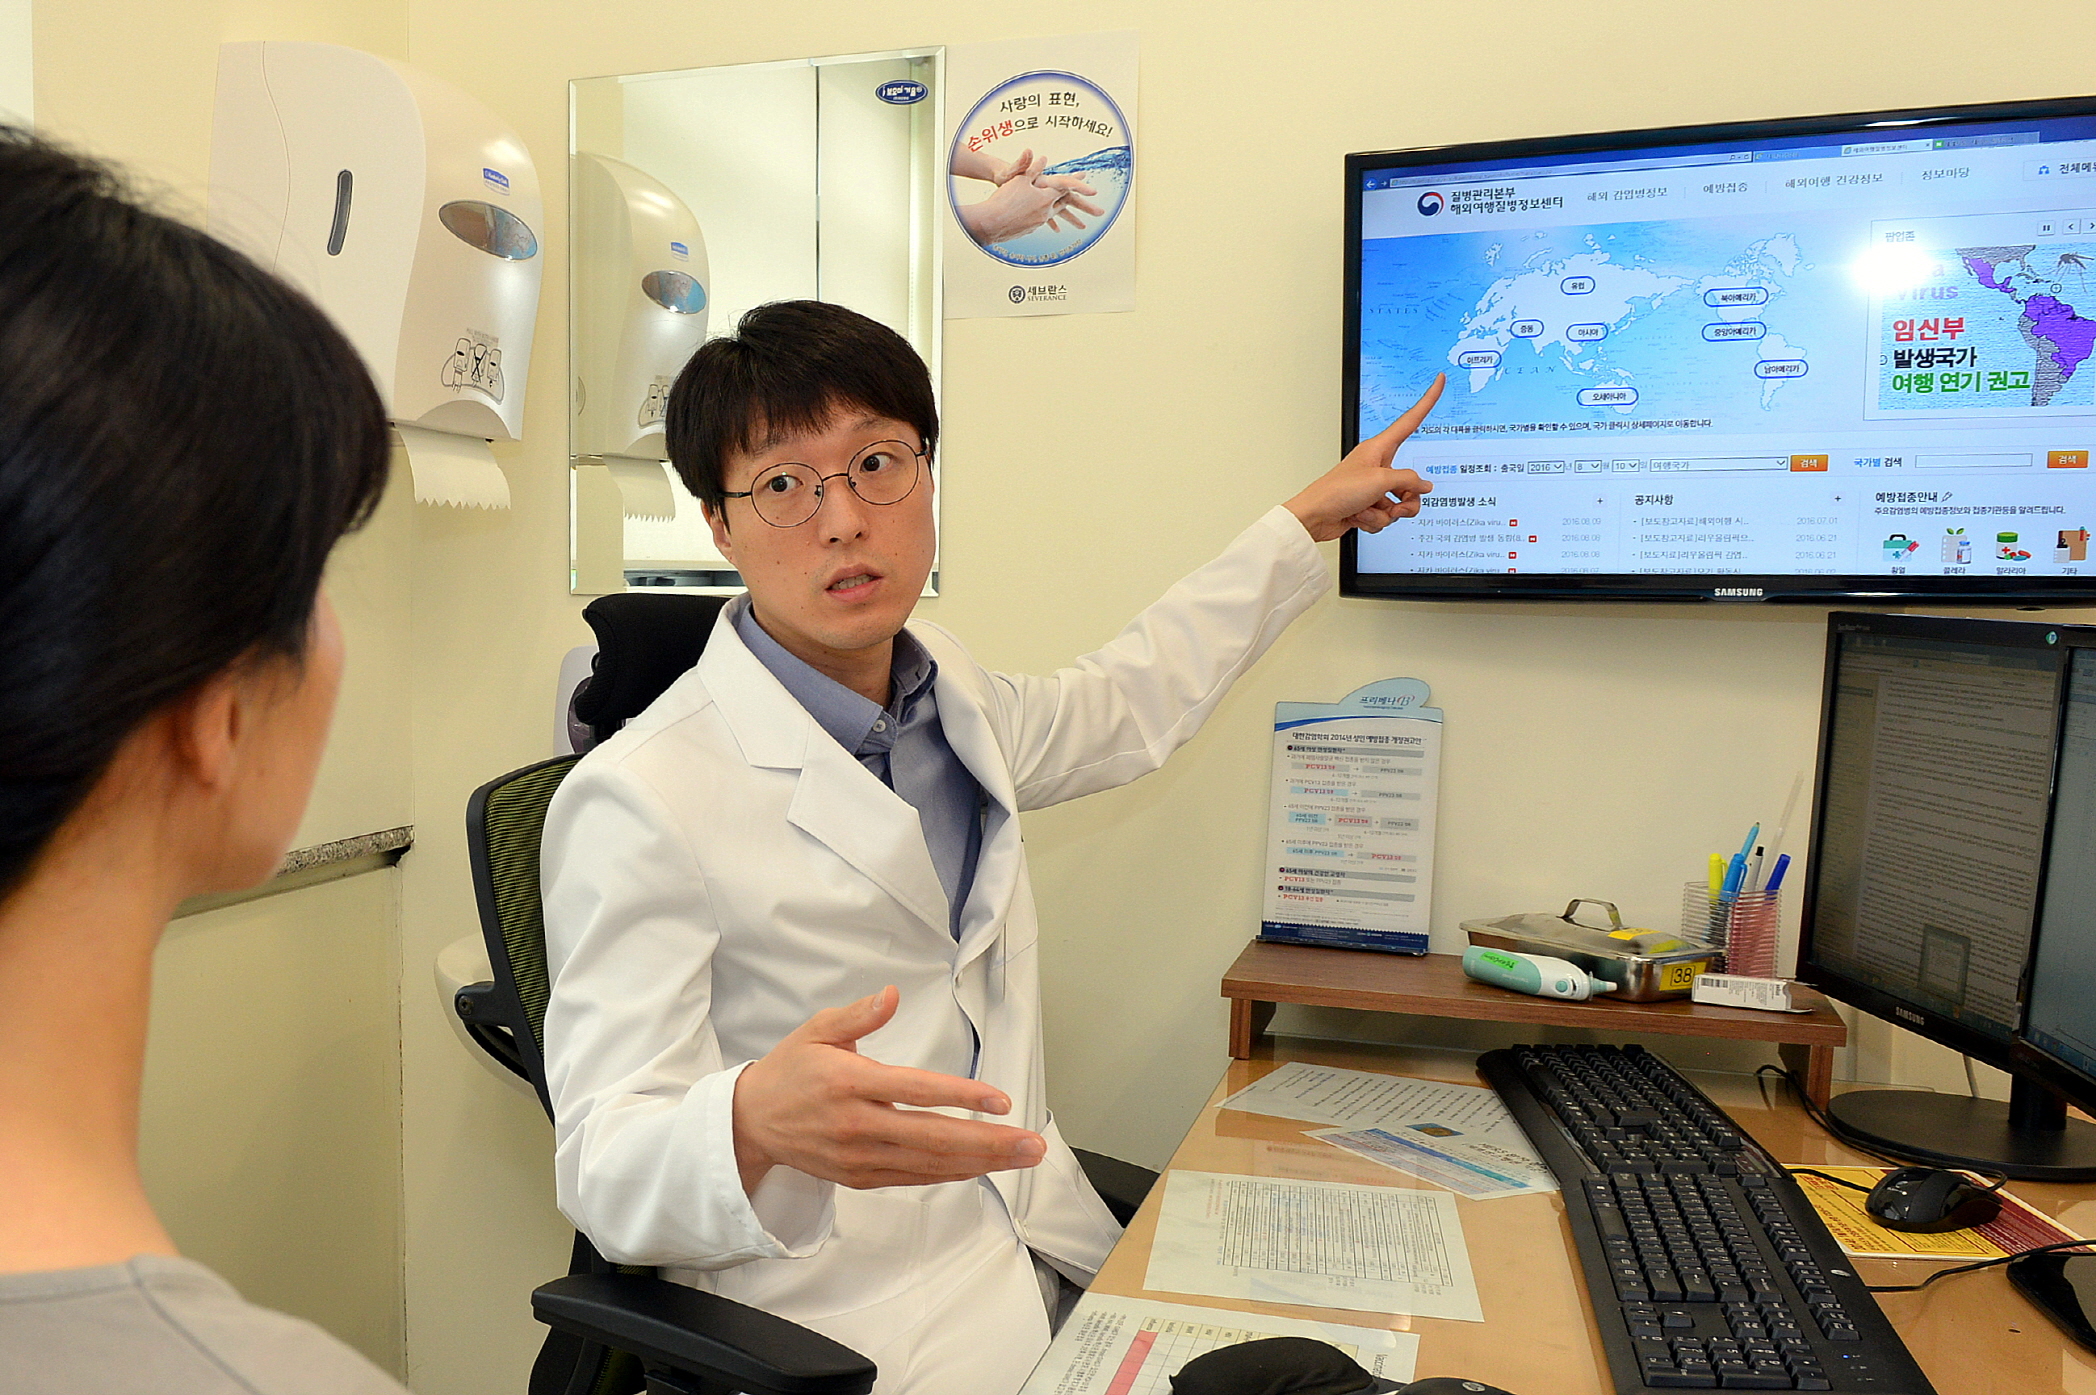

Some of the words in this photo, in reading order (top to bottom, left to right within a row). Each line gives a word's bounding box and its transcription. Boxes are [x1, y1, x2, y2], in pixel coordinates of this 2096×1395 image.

[1000, 94, 1040, 112] 사랑의
[1048, 92, 1079, 107] 표현,
[968, 117, 1039, 152] 손위생으로
[1046, 115, 1113, 137] 시작하세요!
[1921, 167, 1970, 180] 정보마당
[1785, 175, 1831, 189] 해외여행
[1836, 173, 1883, 186] 건강정보
[1703, 182, 1748, 194] 예방접종
[1451, 187, 1516, 202] 질병관리본부
[1587, 191, 1608, 201] 해외
[1450, 197, 1563, 215] 해외여행질병정보센터
[1027, 285, 1067, 295] 세브란스
[1578, 328, 1599, 337] 아시아
[1893, 317, 1965, 342] 임신부
[1894, 347, 1977, 369] 발생국가
[1892, 373, 1935, 394] 여행
[1939, 371, 1981, 392] 연기
[1987, 370, 2031, 391] 권고
[1538, 422, 1558, 432] 확인할
[1593, 421, 1607, 430] 국가
[1675, 418, 1713, 428] 이동합니다.
[1799, 457, 1818, 468] 검색
[1853, 457, 1881, 468] 국가별
[1883, 456, 1902, 468] 검색
[2057, 453, 2078, 465] 검색
[1425, 464, 1457, 475] 예방접종
[1459, 463, 1492, 474] 일정조회
[1500, 463, 1525, 473] 출국일
[1530, 463, 1551, 472] 2016
[1652, 461, 1690, 471] 여행국가
[1421, 497, 1475, 507] 외감염병발생
[1478, 497, 1497, 507] 소식
[1635, 494, 1674, 506] 공지사항
[1875, 492, 1938, 503] 예방접종안내
[2061, 566, 2078, 575] 기타
[1714, 587, 1763, 597] SAMSUNG
[1360, 696, 1396, 705] 프리베나
[1330, 734, 1352, 742] 2014년
[1673, 967, 1692, 983] 38
